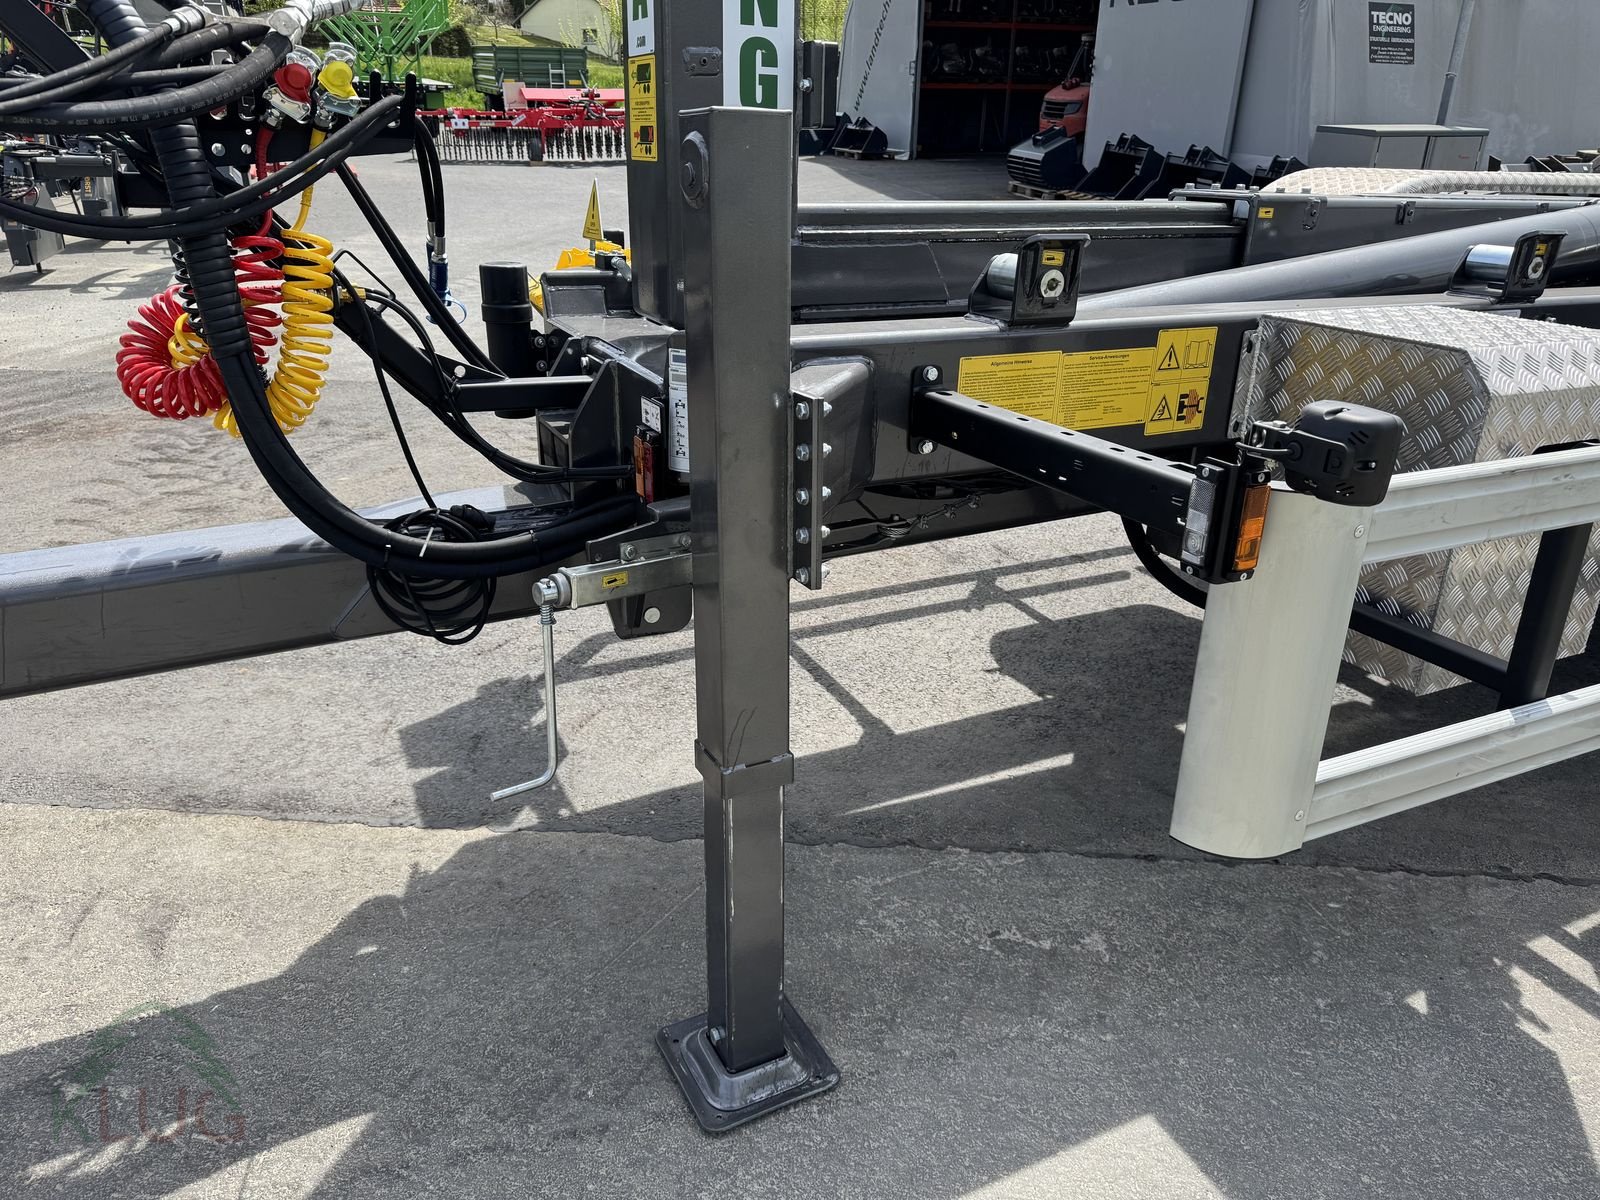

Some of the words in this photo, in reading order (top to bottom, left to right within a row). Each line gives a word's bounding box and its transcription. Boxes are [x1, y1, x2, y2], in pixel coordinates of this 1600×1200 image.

[1371, 11, 1412, 25] TECNO
[1373, 25, 1411, 33] ENGINEERING
[854, 0, 892, 111] www.landtech
